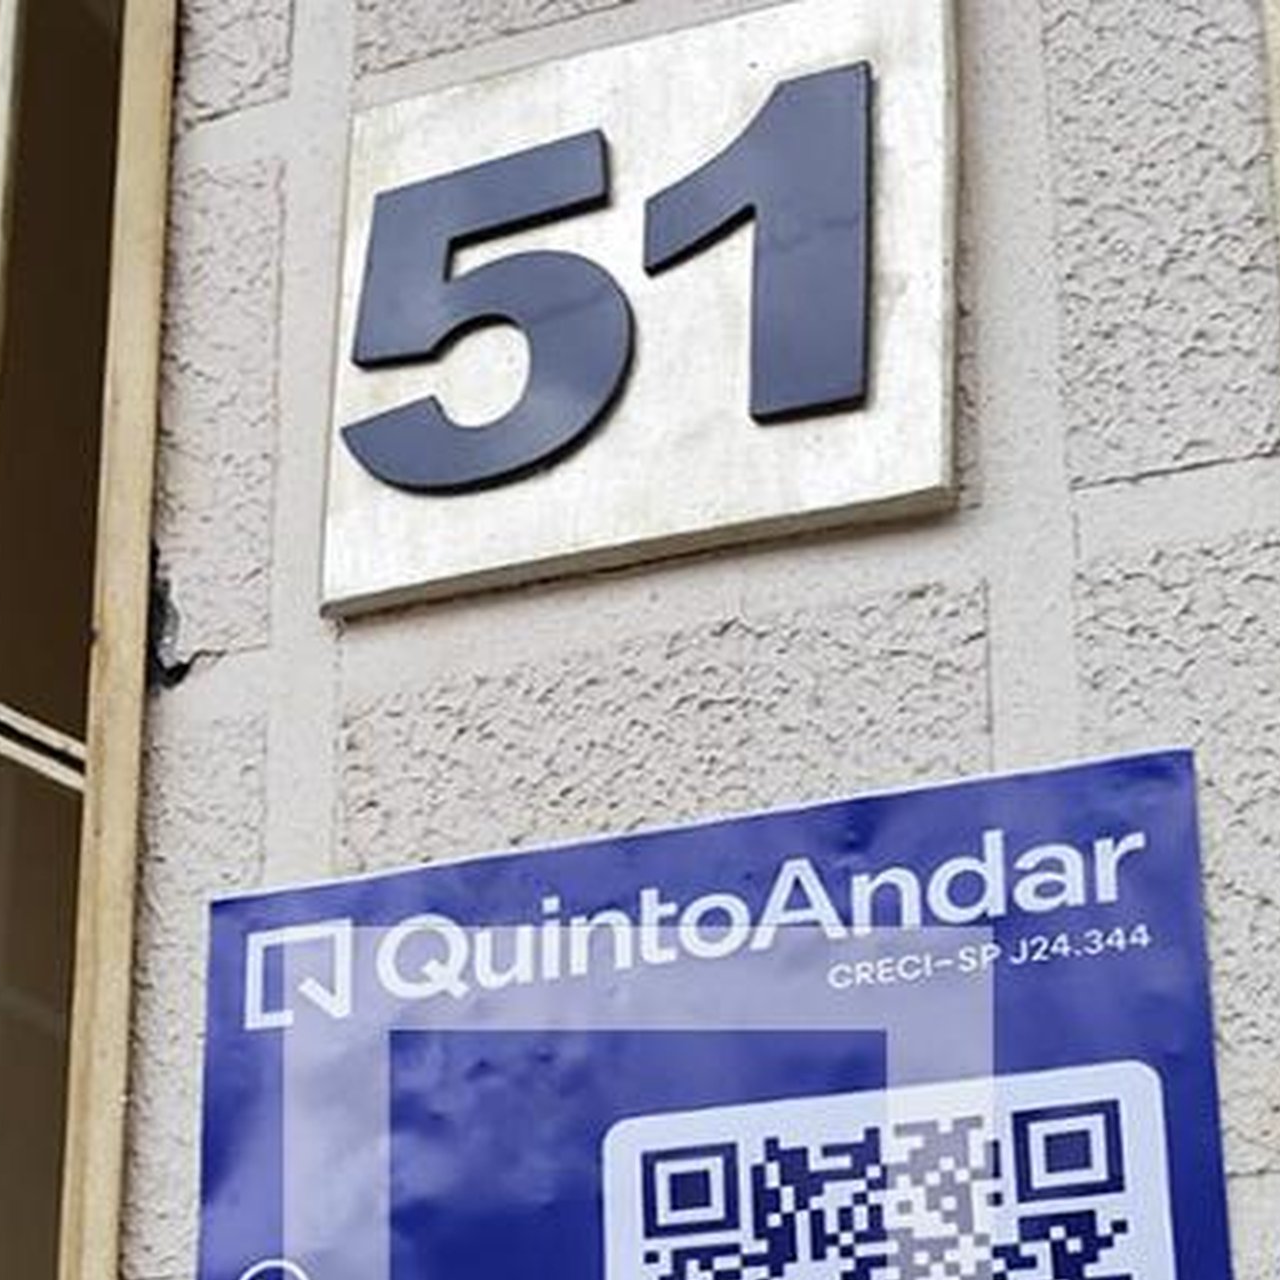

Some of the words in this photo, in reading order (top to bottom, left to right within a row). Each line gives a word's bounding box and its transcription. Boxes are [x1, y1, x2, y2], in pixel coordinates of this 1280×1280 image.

[341, 60, 873, 497] 51
[375, 827, 1147, 1000] QuintoAndar
[826, 943, 1002, 989] CRECI-SP
[1008, 923, 1152, 965] J24.344
